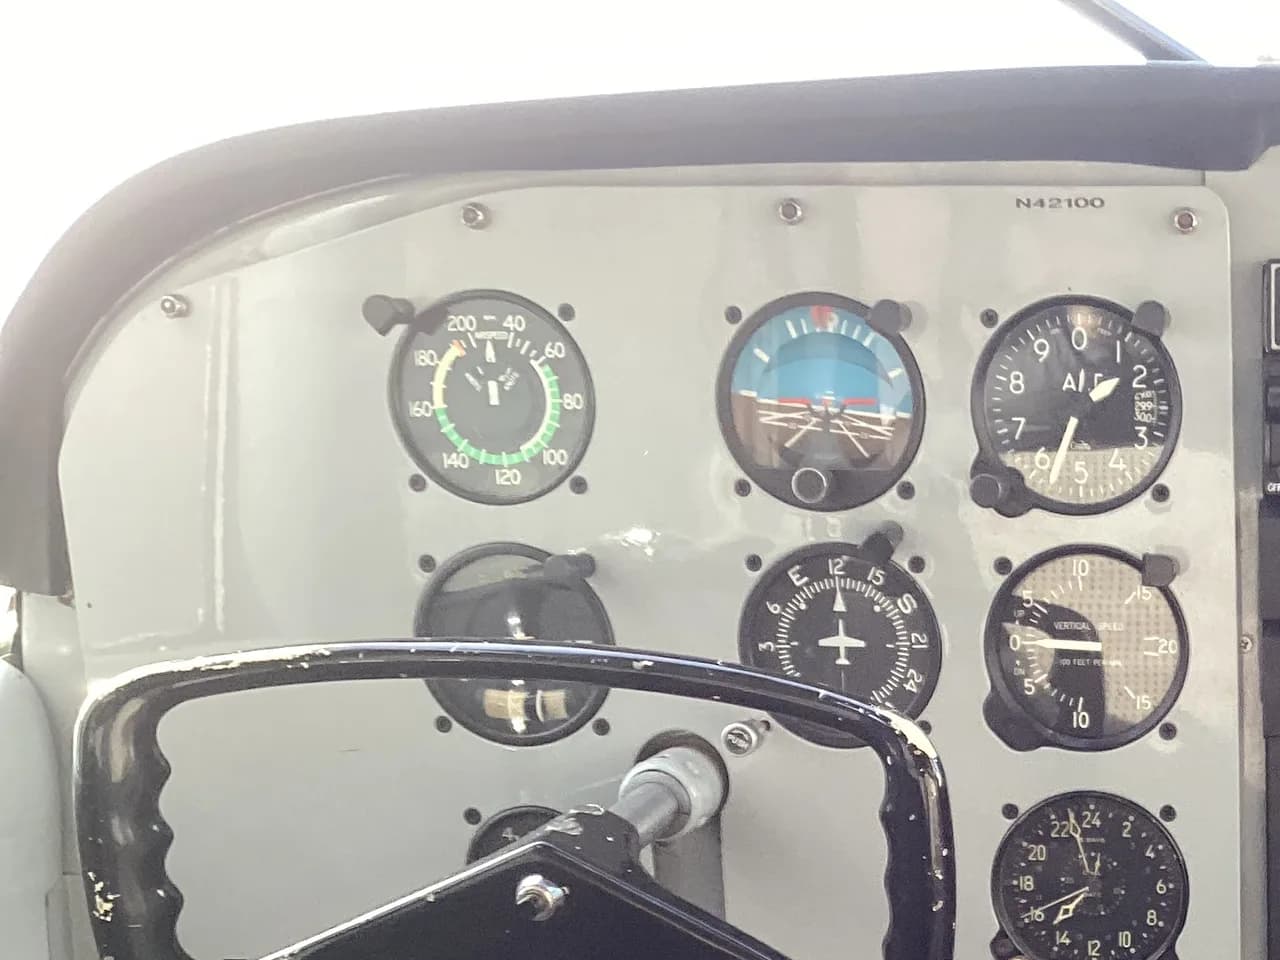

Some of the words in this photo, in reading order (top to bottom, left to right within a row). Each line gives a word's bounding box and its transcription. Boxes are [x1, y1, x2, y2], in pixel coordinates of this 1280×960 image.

[1015, 197, 1105, 209] N42100
[448, 316, 476, 331] 200
[503, 315, 525, 331] 40
[1072, 327, 1088, 350] 0
[415, 350, 437, 366] 180
[545, 342, 565, 358] 60
[1033, 338, 1049, 363] 9
[1116, 340, 1121, 363] 1
[1009, 371, 1025, 394] 8
[1132, 365, 1147, 389] 2
[409, 401, 432, 417] 160
[563, 394, 583, 409] 80
[1011, 417, 1026, 440] 7
[1134, 426, 1148, 449] 3
[443, 453, 469, 469] 140
[542, 449, 568, 465] 100
[1034, 447, 1050, 469] 6
[1108, 448, 1126, 470] 4
[495, 469, 521, 485] 120
[1074, 461, 1088, 484] 5
[828, 559, 845, 575] 12
[1072, 560, 1089, 577] 10
[787, 565, 809, 587] E
[867, 567, 886, 586] 15
[1023, 590, 1034, 607] 5
[1136, 585, 1152, 600] 15
[766, 600, 782, 614] 6
[897, 593, 918, 614] S
[758, 641, 774, 652] 3
[911, 632, 928, 649] 21
[1009, 635, 1021, 651] 0
[1158, 640, 1177, 654] 20
[902, 669, 923, 693] 24
[1024, 678, 1036, 695] 5
[1136, 696, 1151, 710] 15
[1072, 712, 1090, 728] 10
[1082, 811, 1101, 828] 24
[1051, 821, 1070, 838] 22
[1122, 822, 1132, 838] 2
[1028, 844, 1046, 861] 20
[1145, 845, 1156, 859] 4
[1019, 875, 1034, 891] 18
[1156, 880, 1167, 894] 6
[1030, 906, 1044, 922] 16
[1146, 910, 1157, 926] 8
[1056, 930, 1071, 946] 14
[1118, 931, 1131, 948] 10
[1087, 940, 1100, 956] 12
